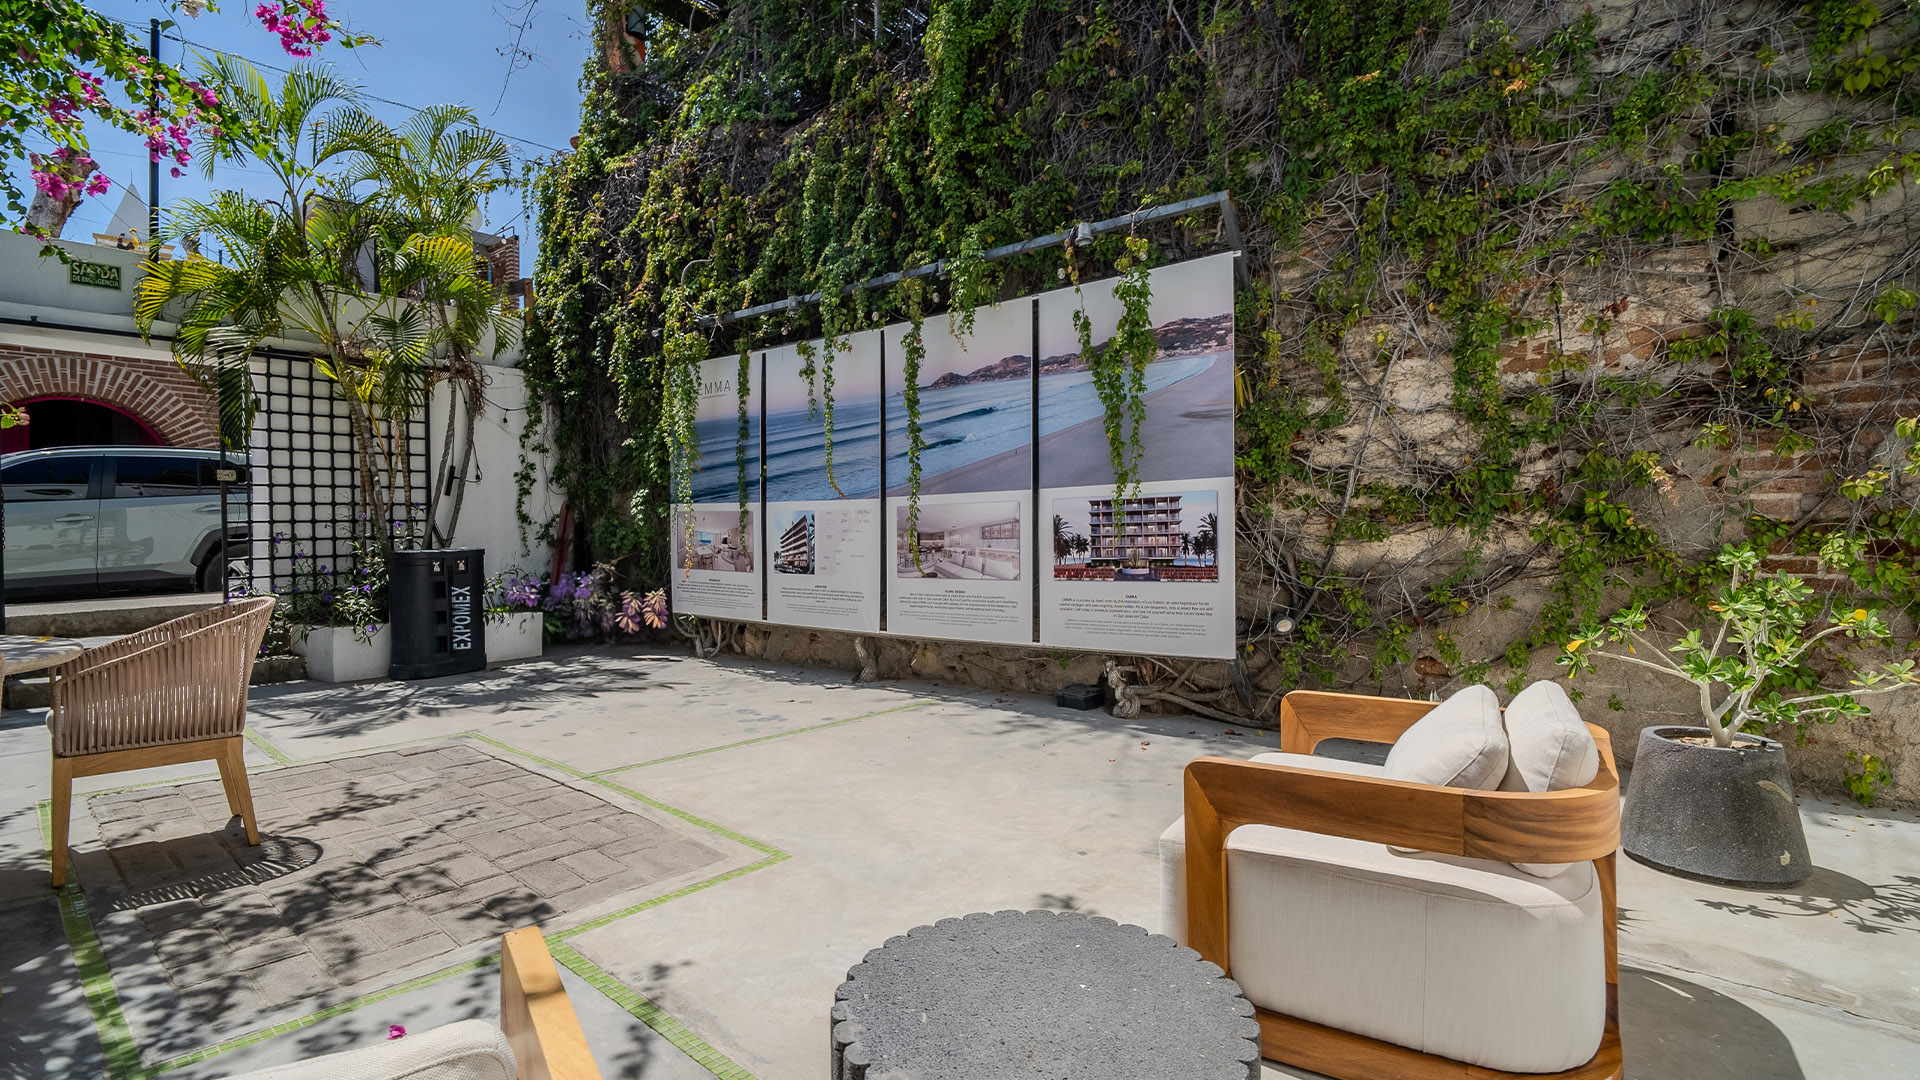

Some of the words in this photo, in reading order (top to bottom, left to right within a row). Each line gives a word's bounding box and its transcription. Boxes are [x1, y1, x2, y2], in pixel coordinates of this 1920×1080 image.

[72, 262, 119, 280] SADA
[82, 276, 118, 286] EMGENCIA
[451, 586, 472, 650] EXPOMEX
